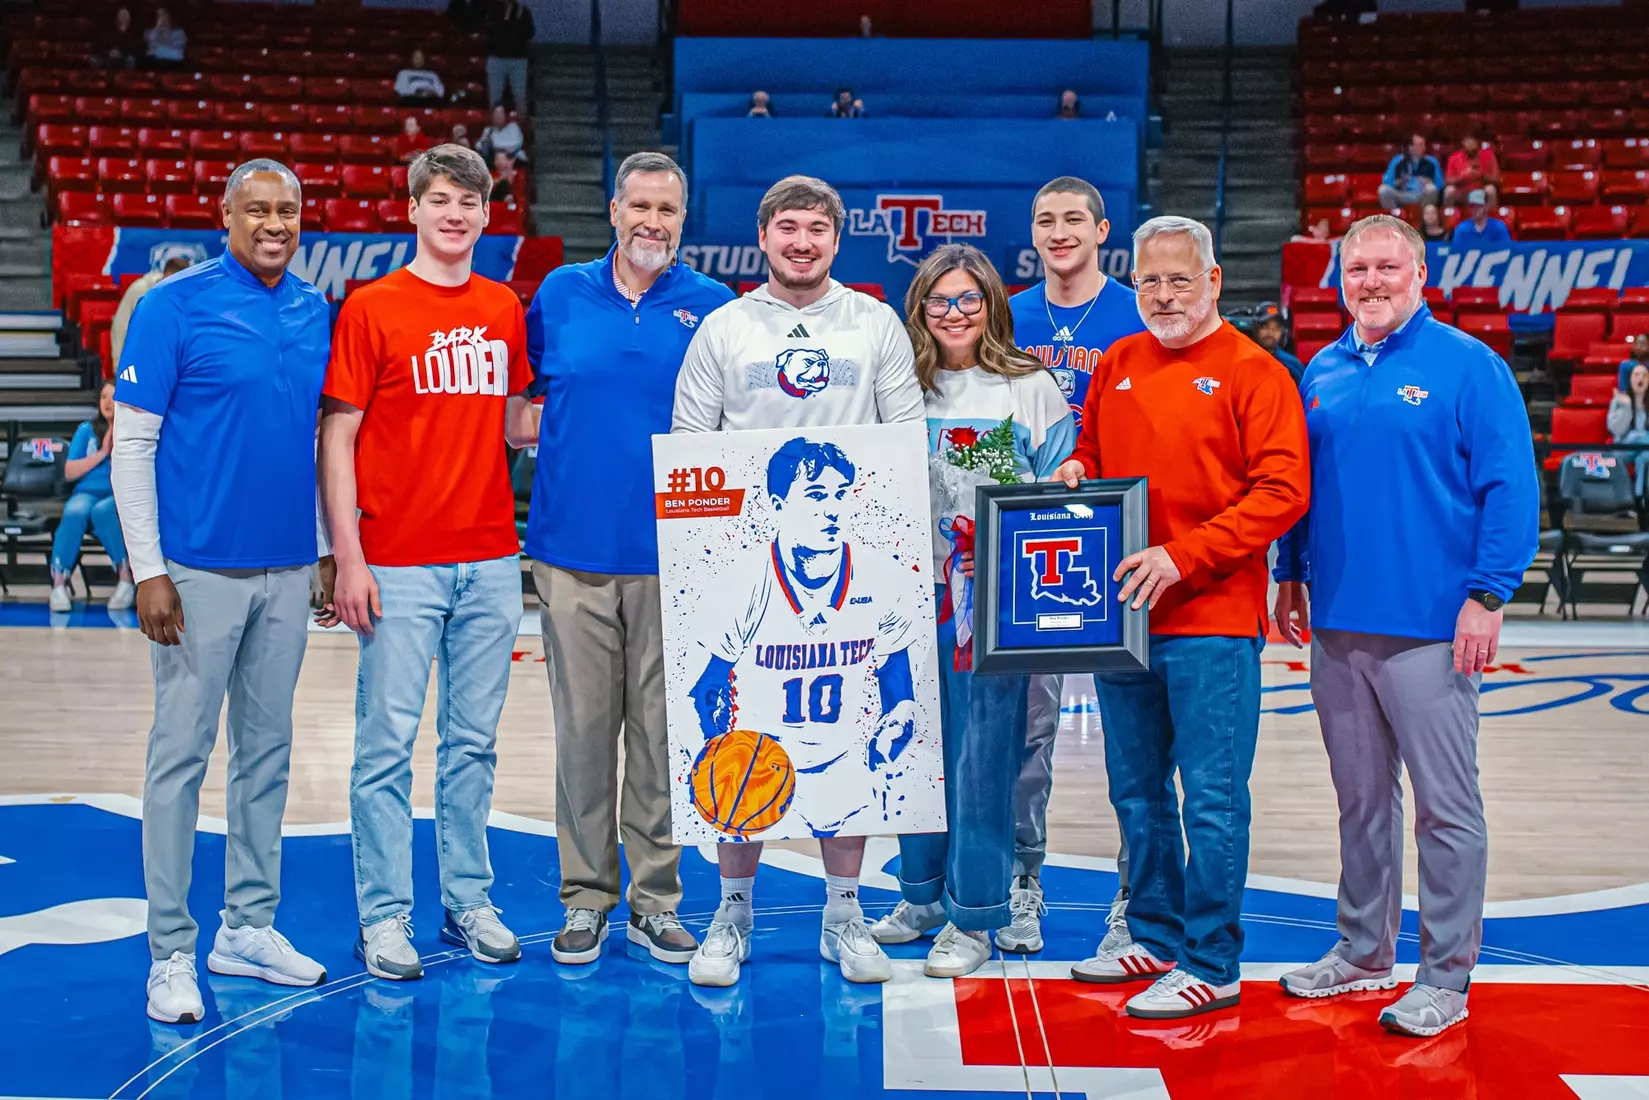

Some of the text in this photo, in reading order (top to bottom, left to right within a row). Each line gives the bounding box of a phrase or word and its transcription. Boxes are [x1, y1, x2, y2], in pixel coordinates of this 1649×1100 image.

[849, 194, 987, 252] LA TECH
[680, 245, 769, 275] STUD
[426, 325, 488, 353] BARK
[410, 339, 509, 397] LOUDER
[667, 466, 726, 493] #10
[665, 498, 730, 508] BEN PONDER
[1029, 511, 1071, 521] Louisiana
[782, 673, 844, 724] 10
